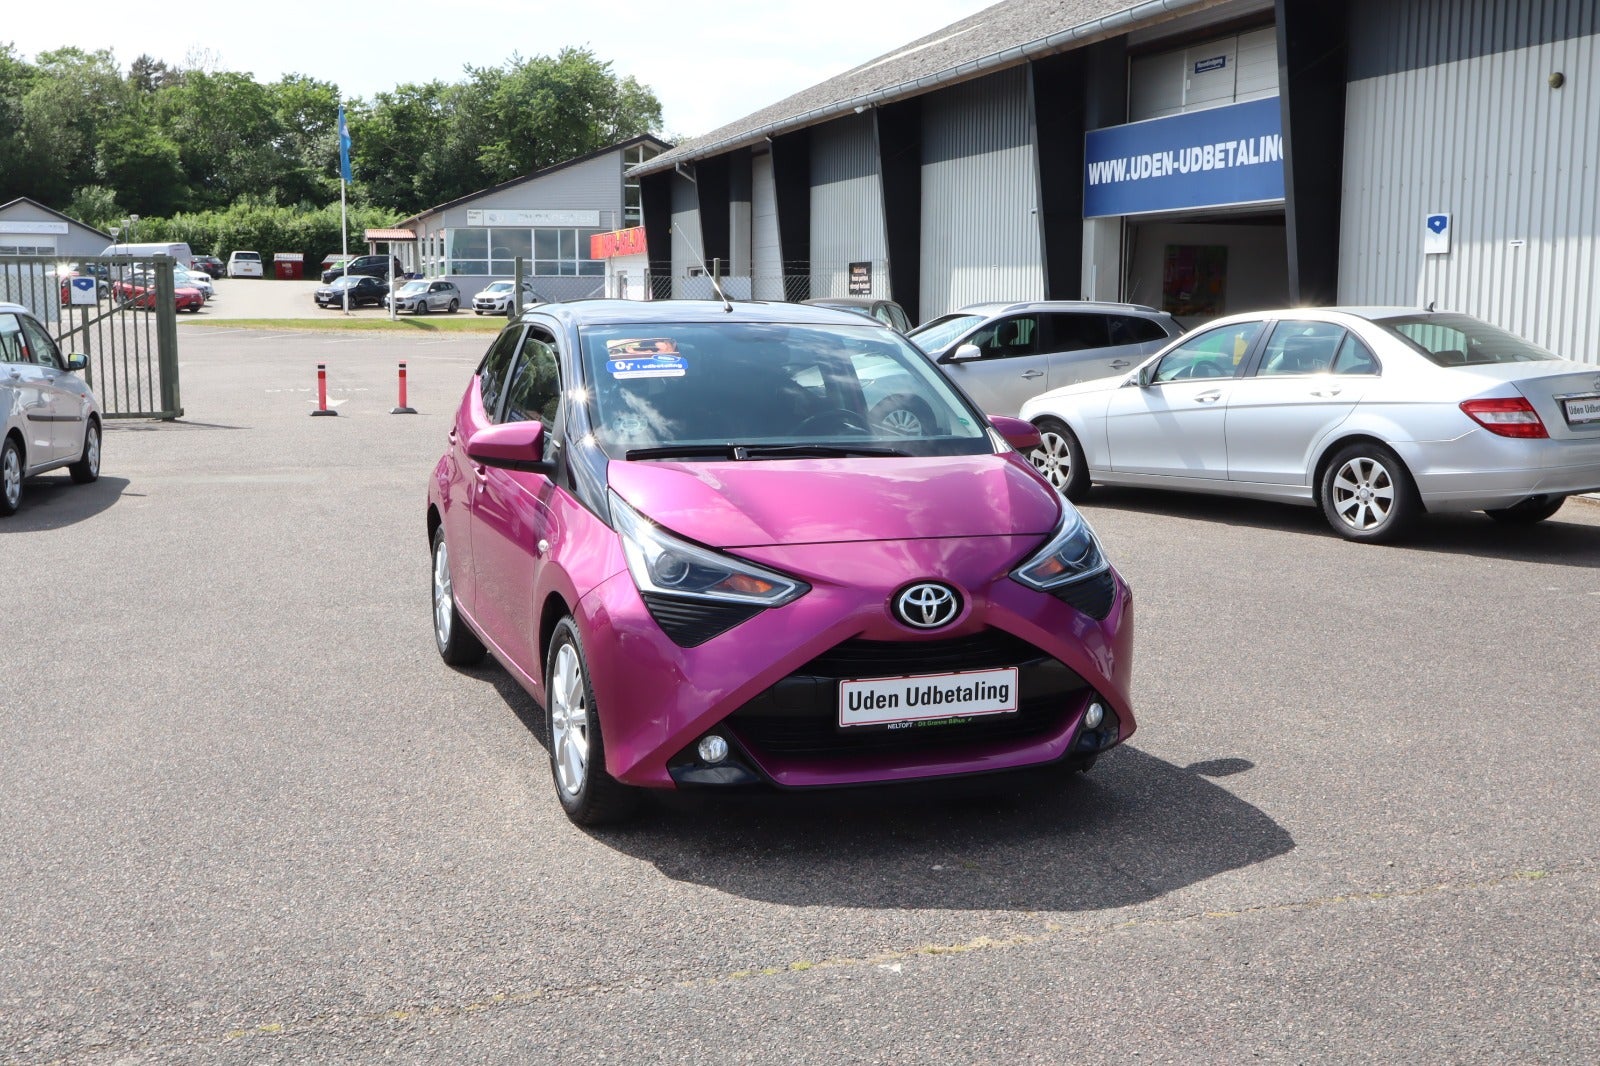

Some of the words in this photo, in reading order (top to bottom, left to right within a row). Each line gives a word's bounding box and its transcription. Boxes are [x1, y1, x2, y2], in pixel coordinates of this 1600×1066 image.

[1568, 405, 1584, 415] Uden
[848, 690, 899, 711] Uden
[906, 681, 1009, 707] Udbetaling
